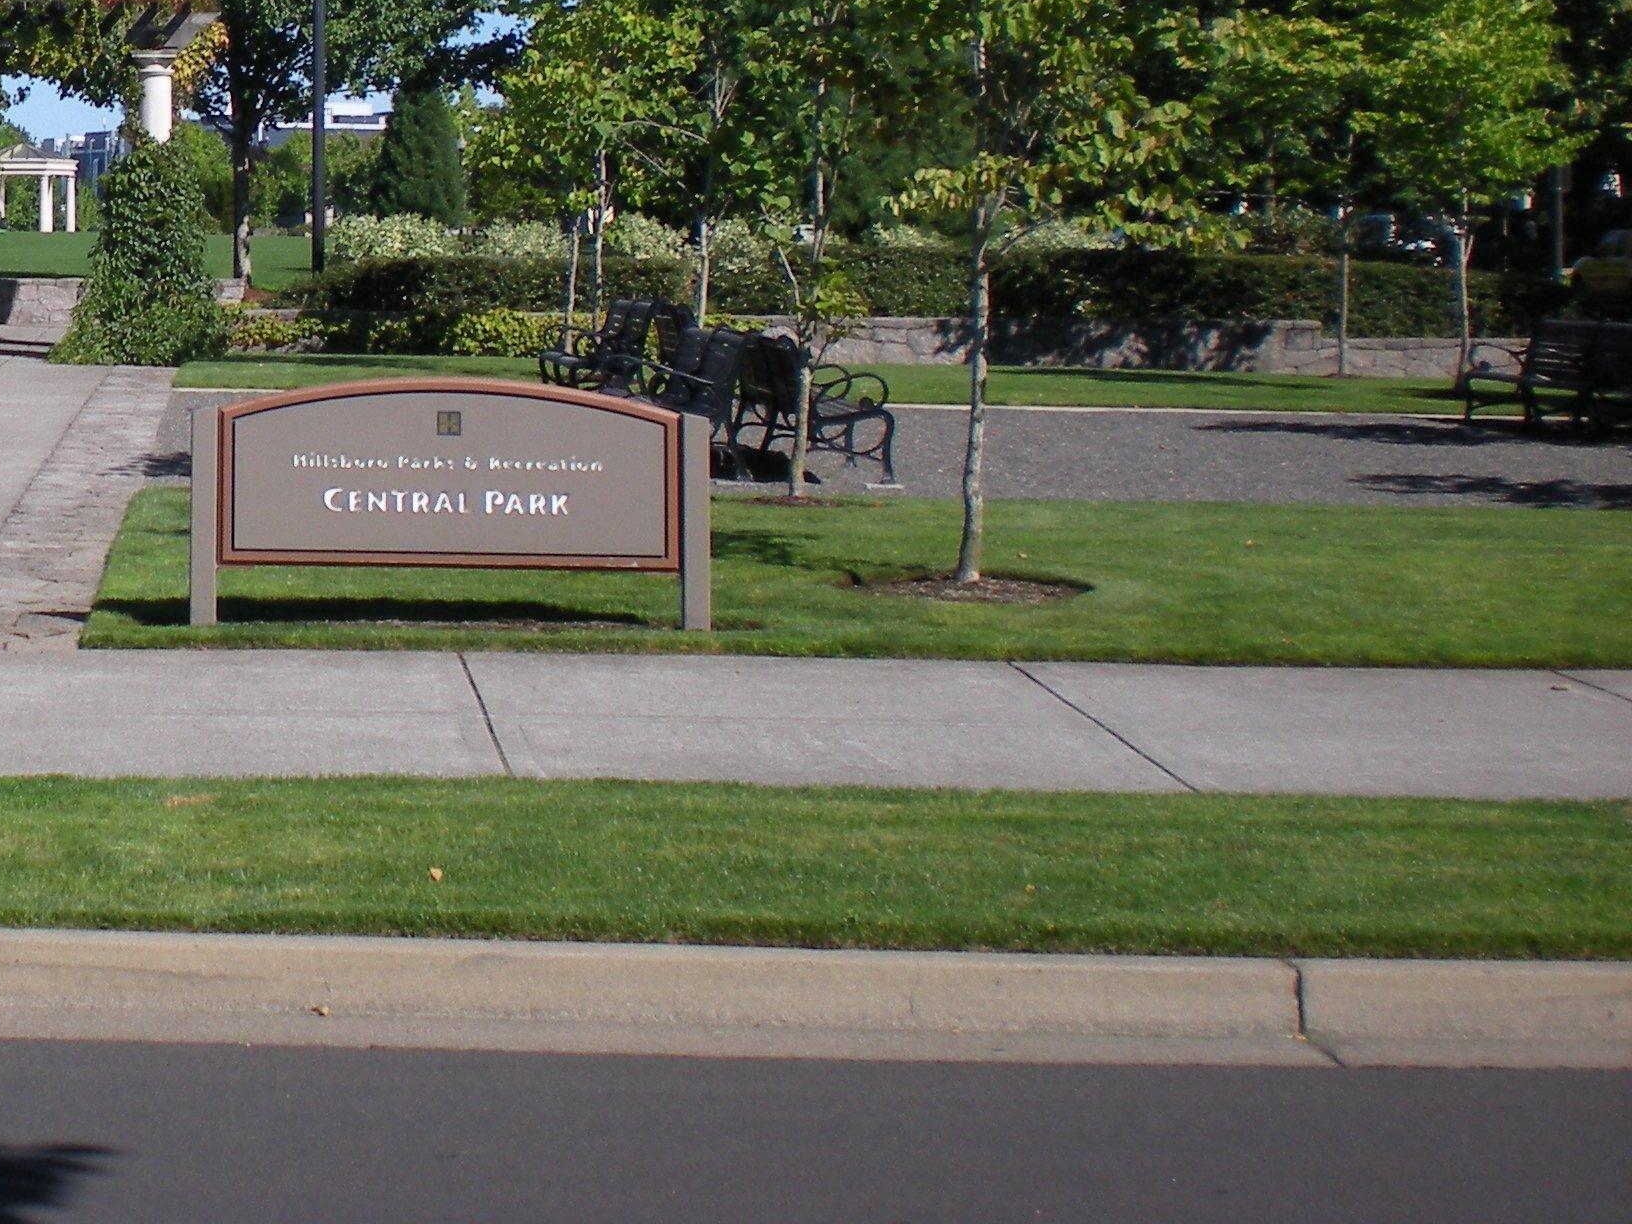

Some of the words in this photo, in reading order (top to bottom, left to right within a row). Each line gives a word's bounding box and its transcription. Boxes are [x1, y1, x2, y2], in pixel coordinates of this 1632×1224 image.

[292, 453, 388, 470] Hillsboro
[397, 455, 454, 470] Parks
[464, 455, 477, 470] &
[488, 455, 604, 472] Recreation
